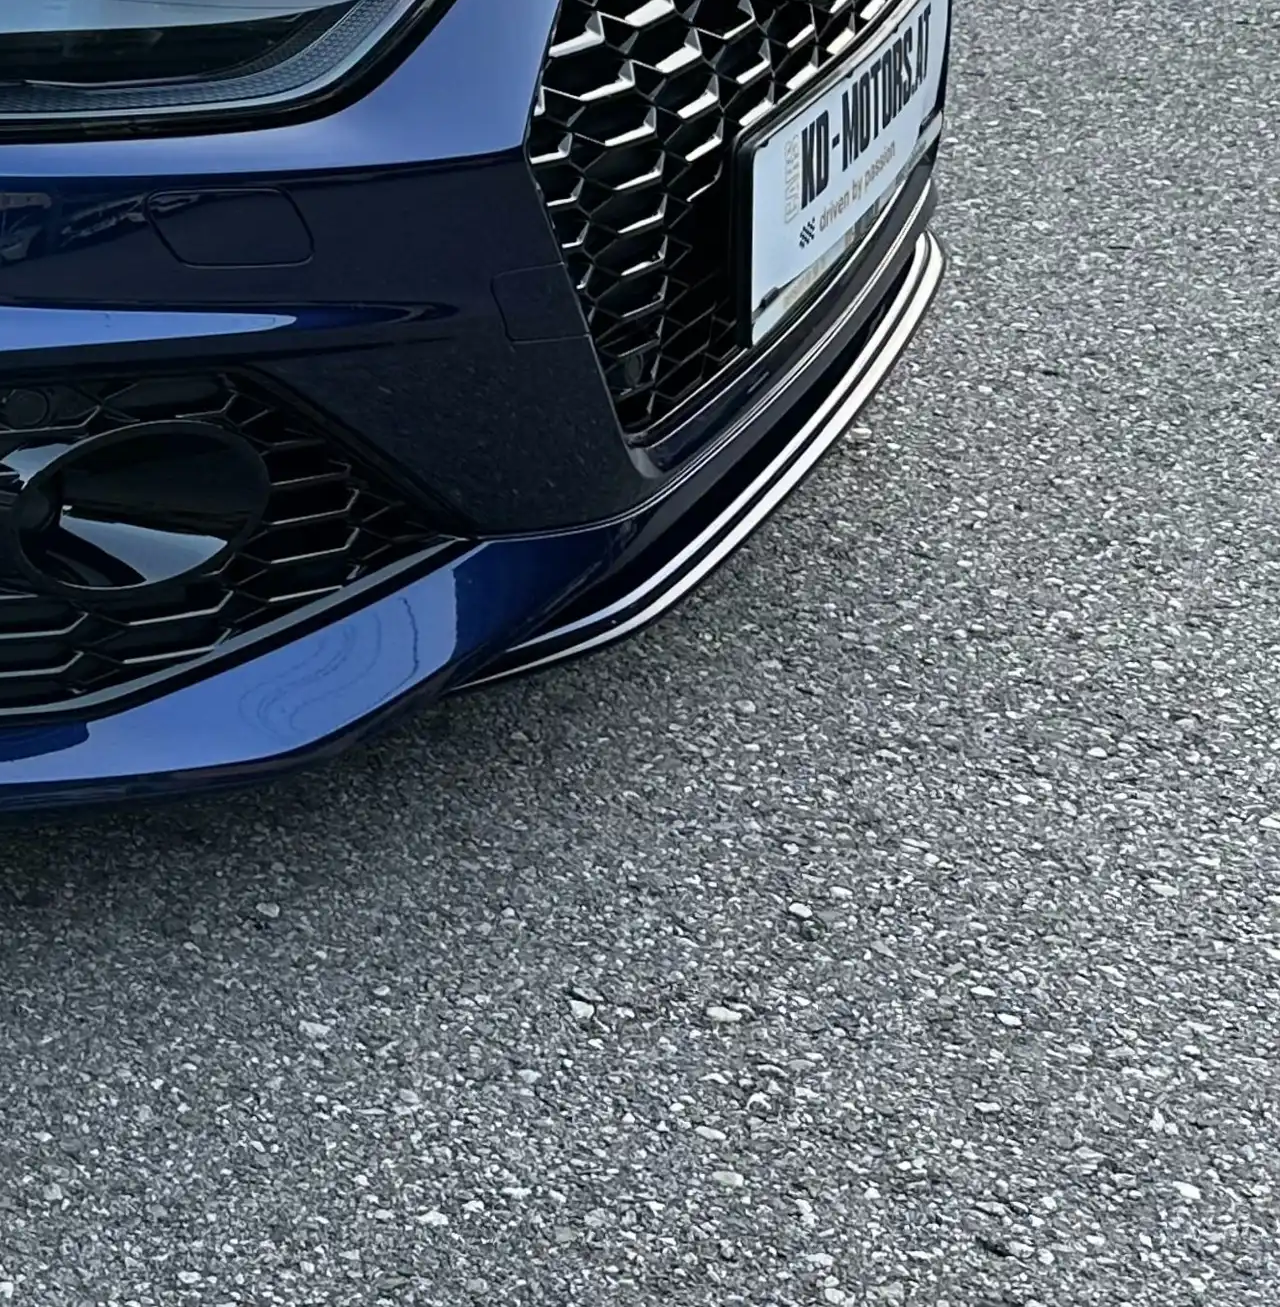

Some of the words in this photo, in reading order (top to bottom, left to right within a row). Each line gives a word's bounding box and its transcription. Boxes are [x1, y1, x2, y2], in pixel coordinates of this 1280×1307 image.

[819, 189, 850, 232] driven
[852, 176, 864, 201] by
[864, 139, 896, 194] passion
